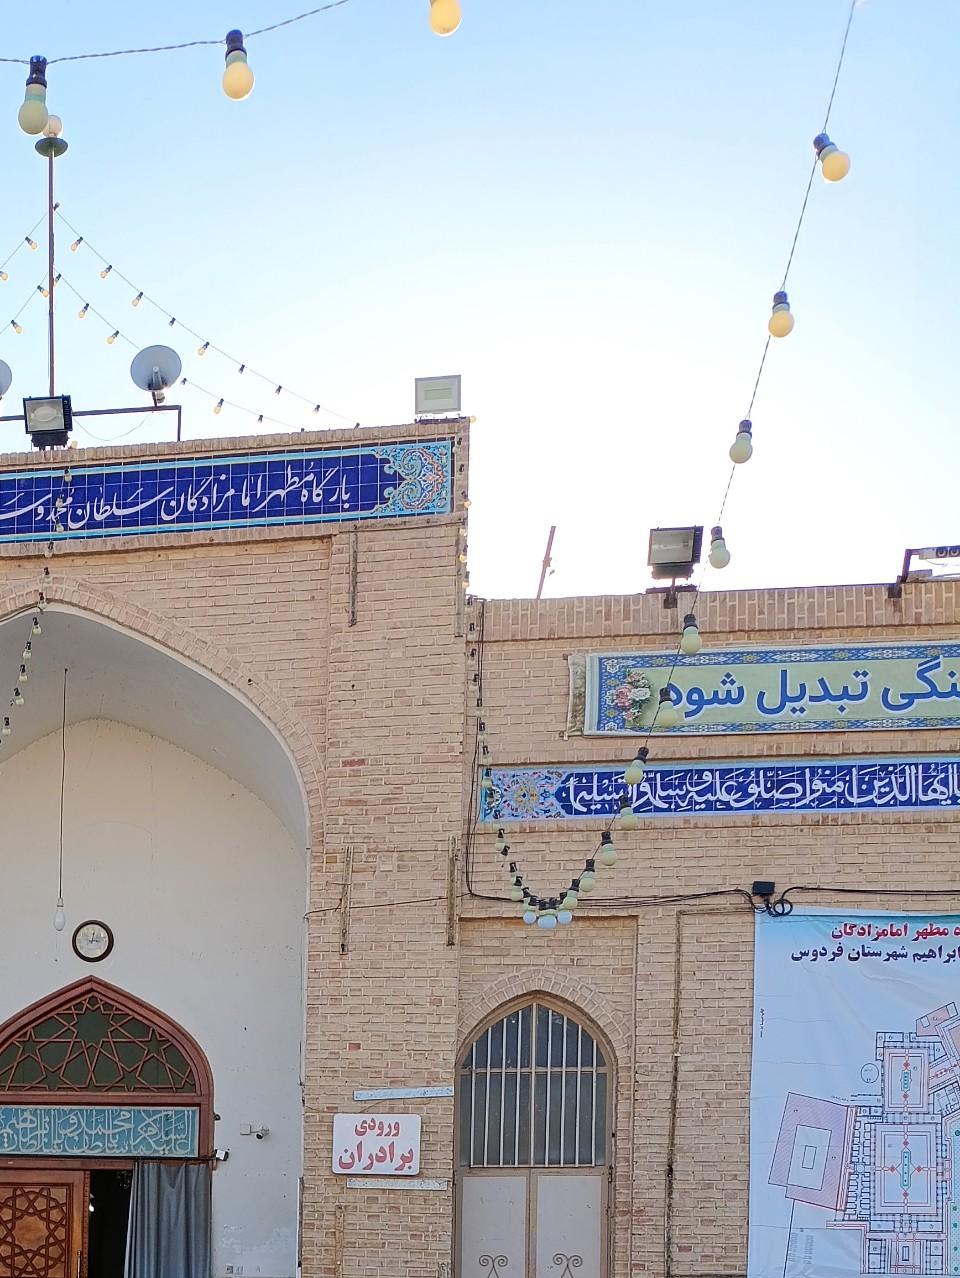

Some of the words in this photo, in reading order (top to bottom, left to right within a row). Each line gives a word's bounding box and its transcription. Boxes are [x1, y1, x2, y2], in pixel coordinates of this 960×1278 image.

[161, 474, 263, 521] امامزادگان
[252, 462, 314, 512] مطهر
[301, 466, 350, 509] بارگاه
[68, 487, 174, 529] سلطان
[667, 672, 745, 718] شود
[757, 669, 869, 715] تبدیل
[831, 922, 908, 941] امامزادگان
[911, 923, 949, 941] مطهر
[791, 942, 844, 962] فردوس
[847, 945, 908, 962] شهرستان
[354, 1118, 400, 1136] ورودی
[338, 1141, 414, 1171] برادران
